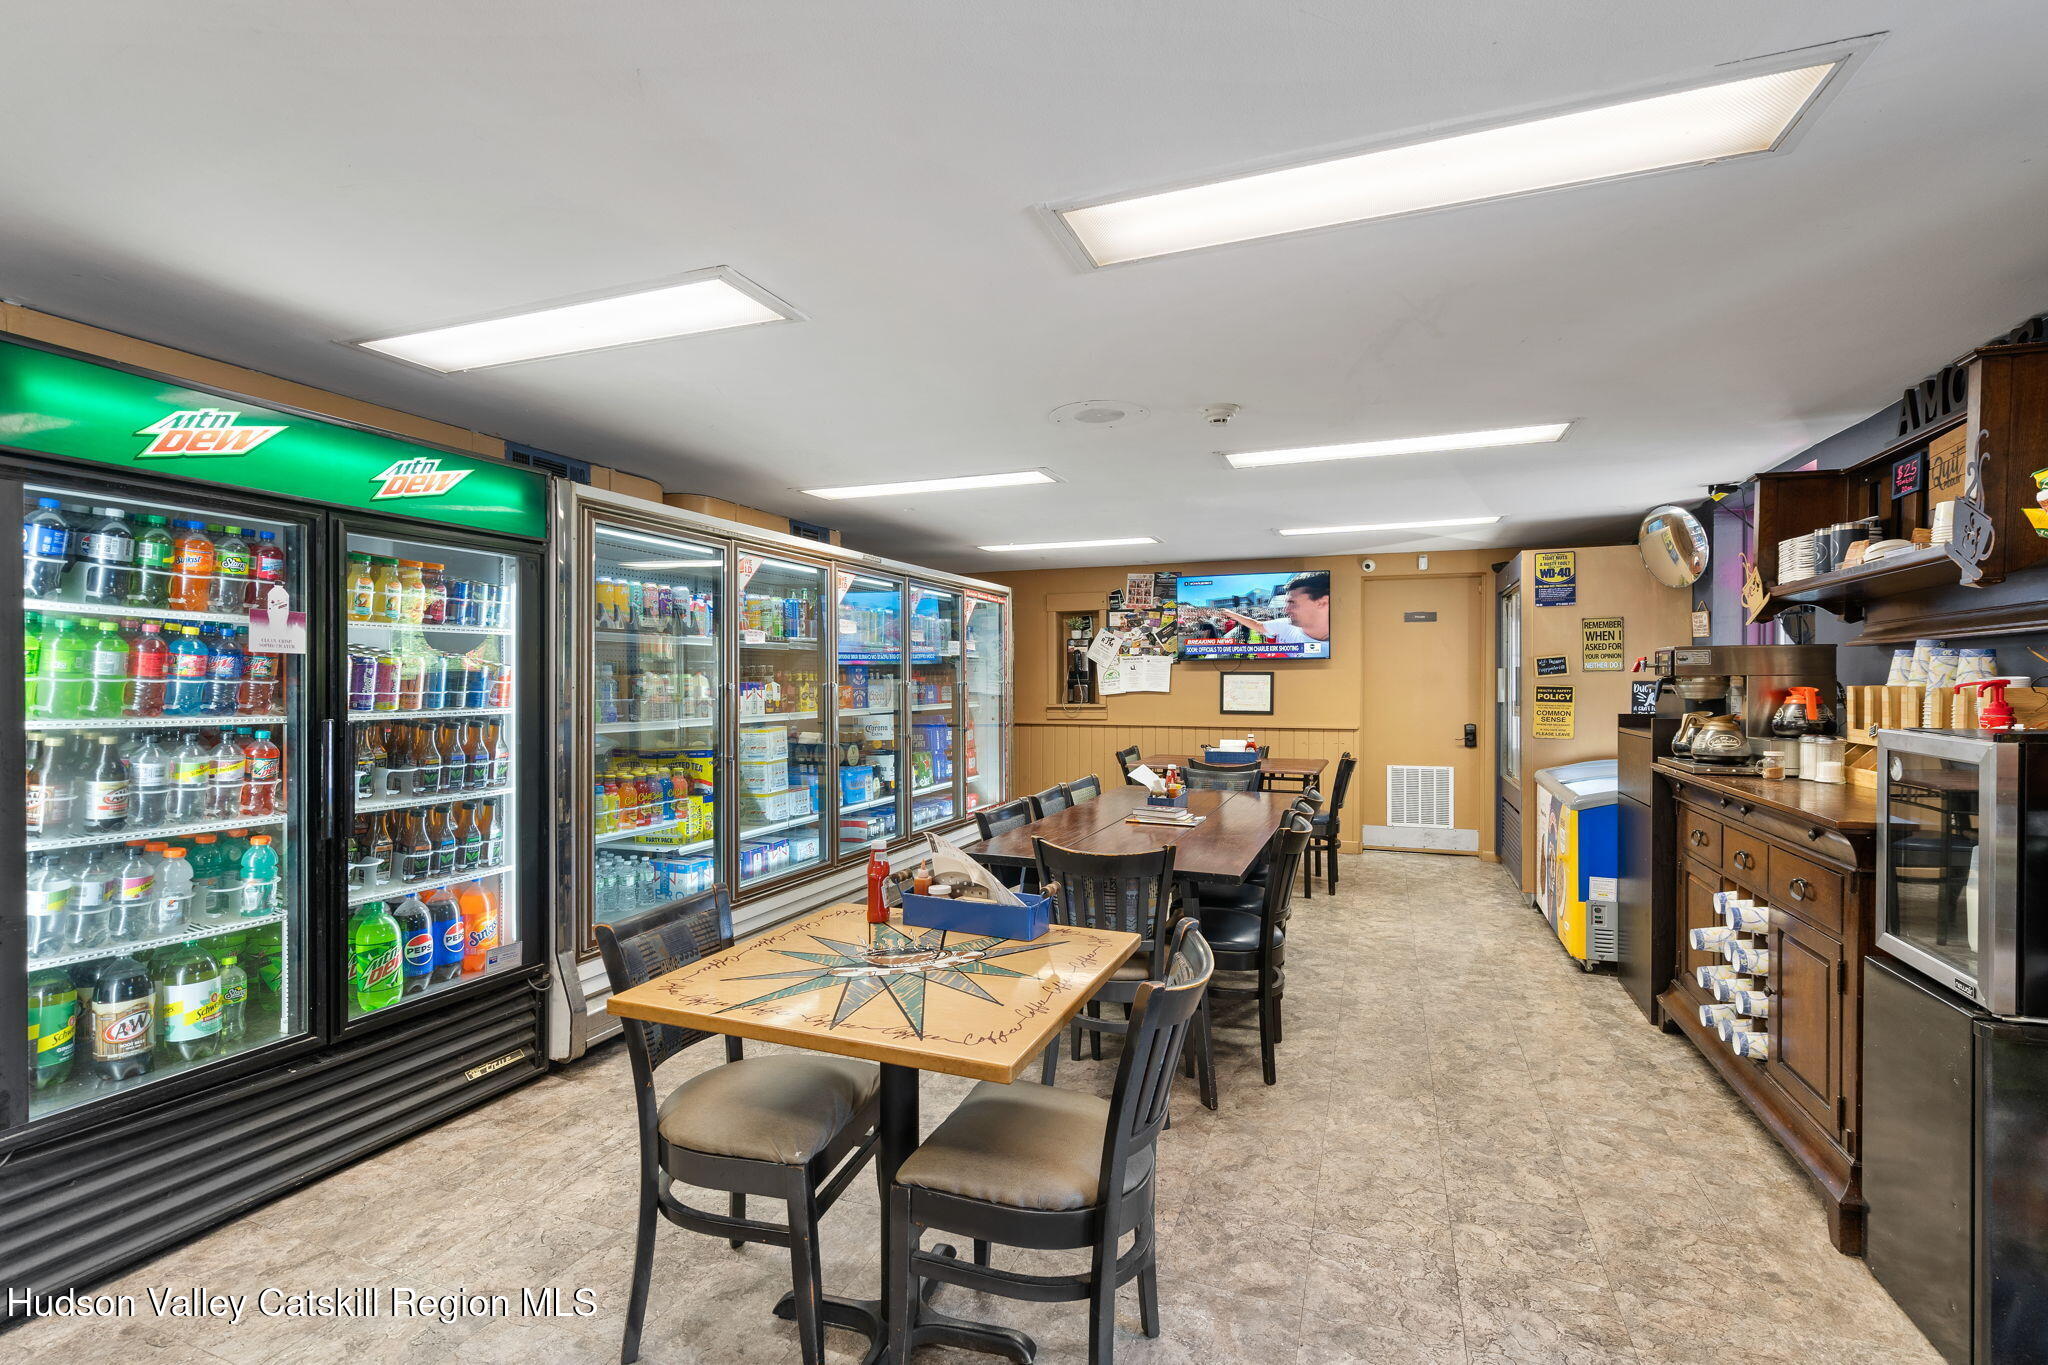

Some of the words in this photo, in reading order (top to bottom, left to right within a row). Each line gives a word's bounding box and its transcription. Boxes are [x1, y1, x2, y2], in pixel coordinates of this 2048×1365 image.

[1897, 461, 1918, 480] $25
[1539, 567, 1571, 578] WD-40
[1583, 620, 1622, 629] REMEMBER
[1584, 630, 1615, 641] WHEN
[1618, 630, 1622, 641] I
[1584, 643, 1607, 651] ASKED
[1608, 642, 1622, 650] FOR
[1536, 709, 1571, 717] COMMON
[866, 723, 888, 732] Corona
